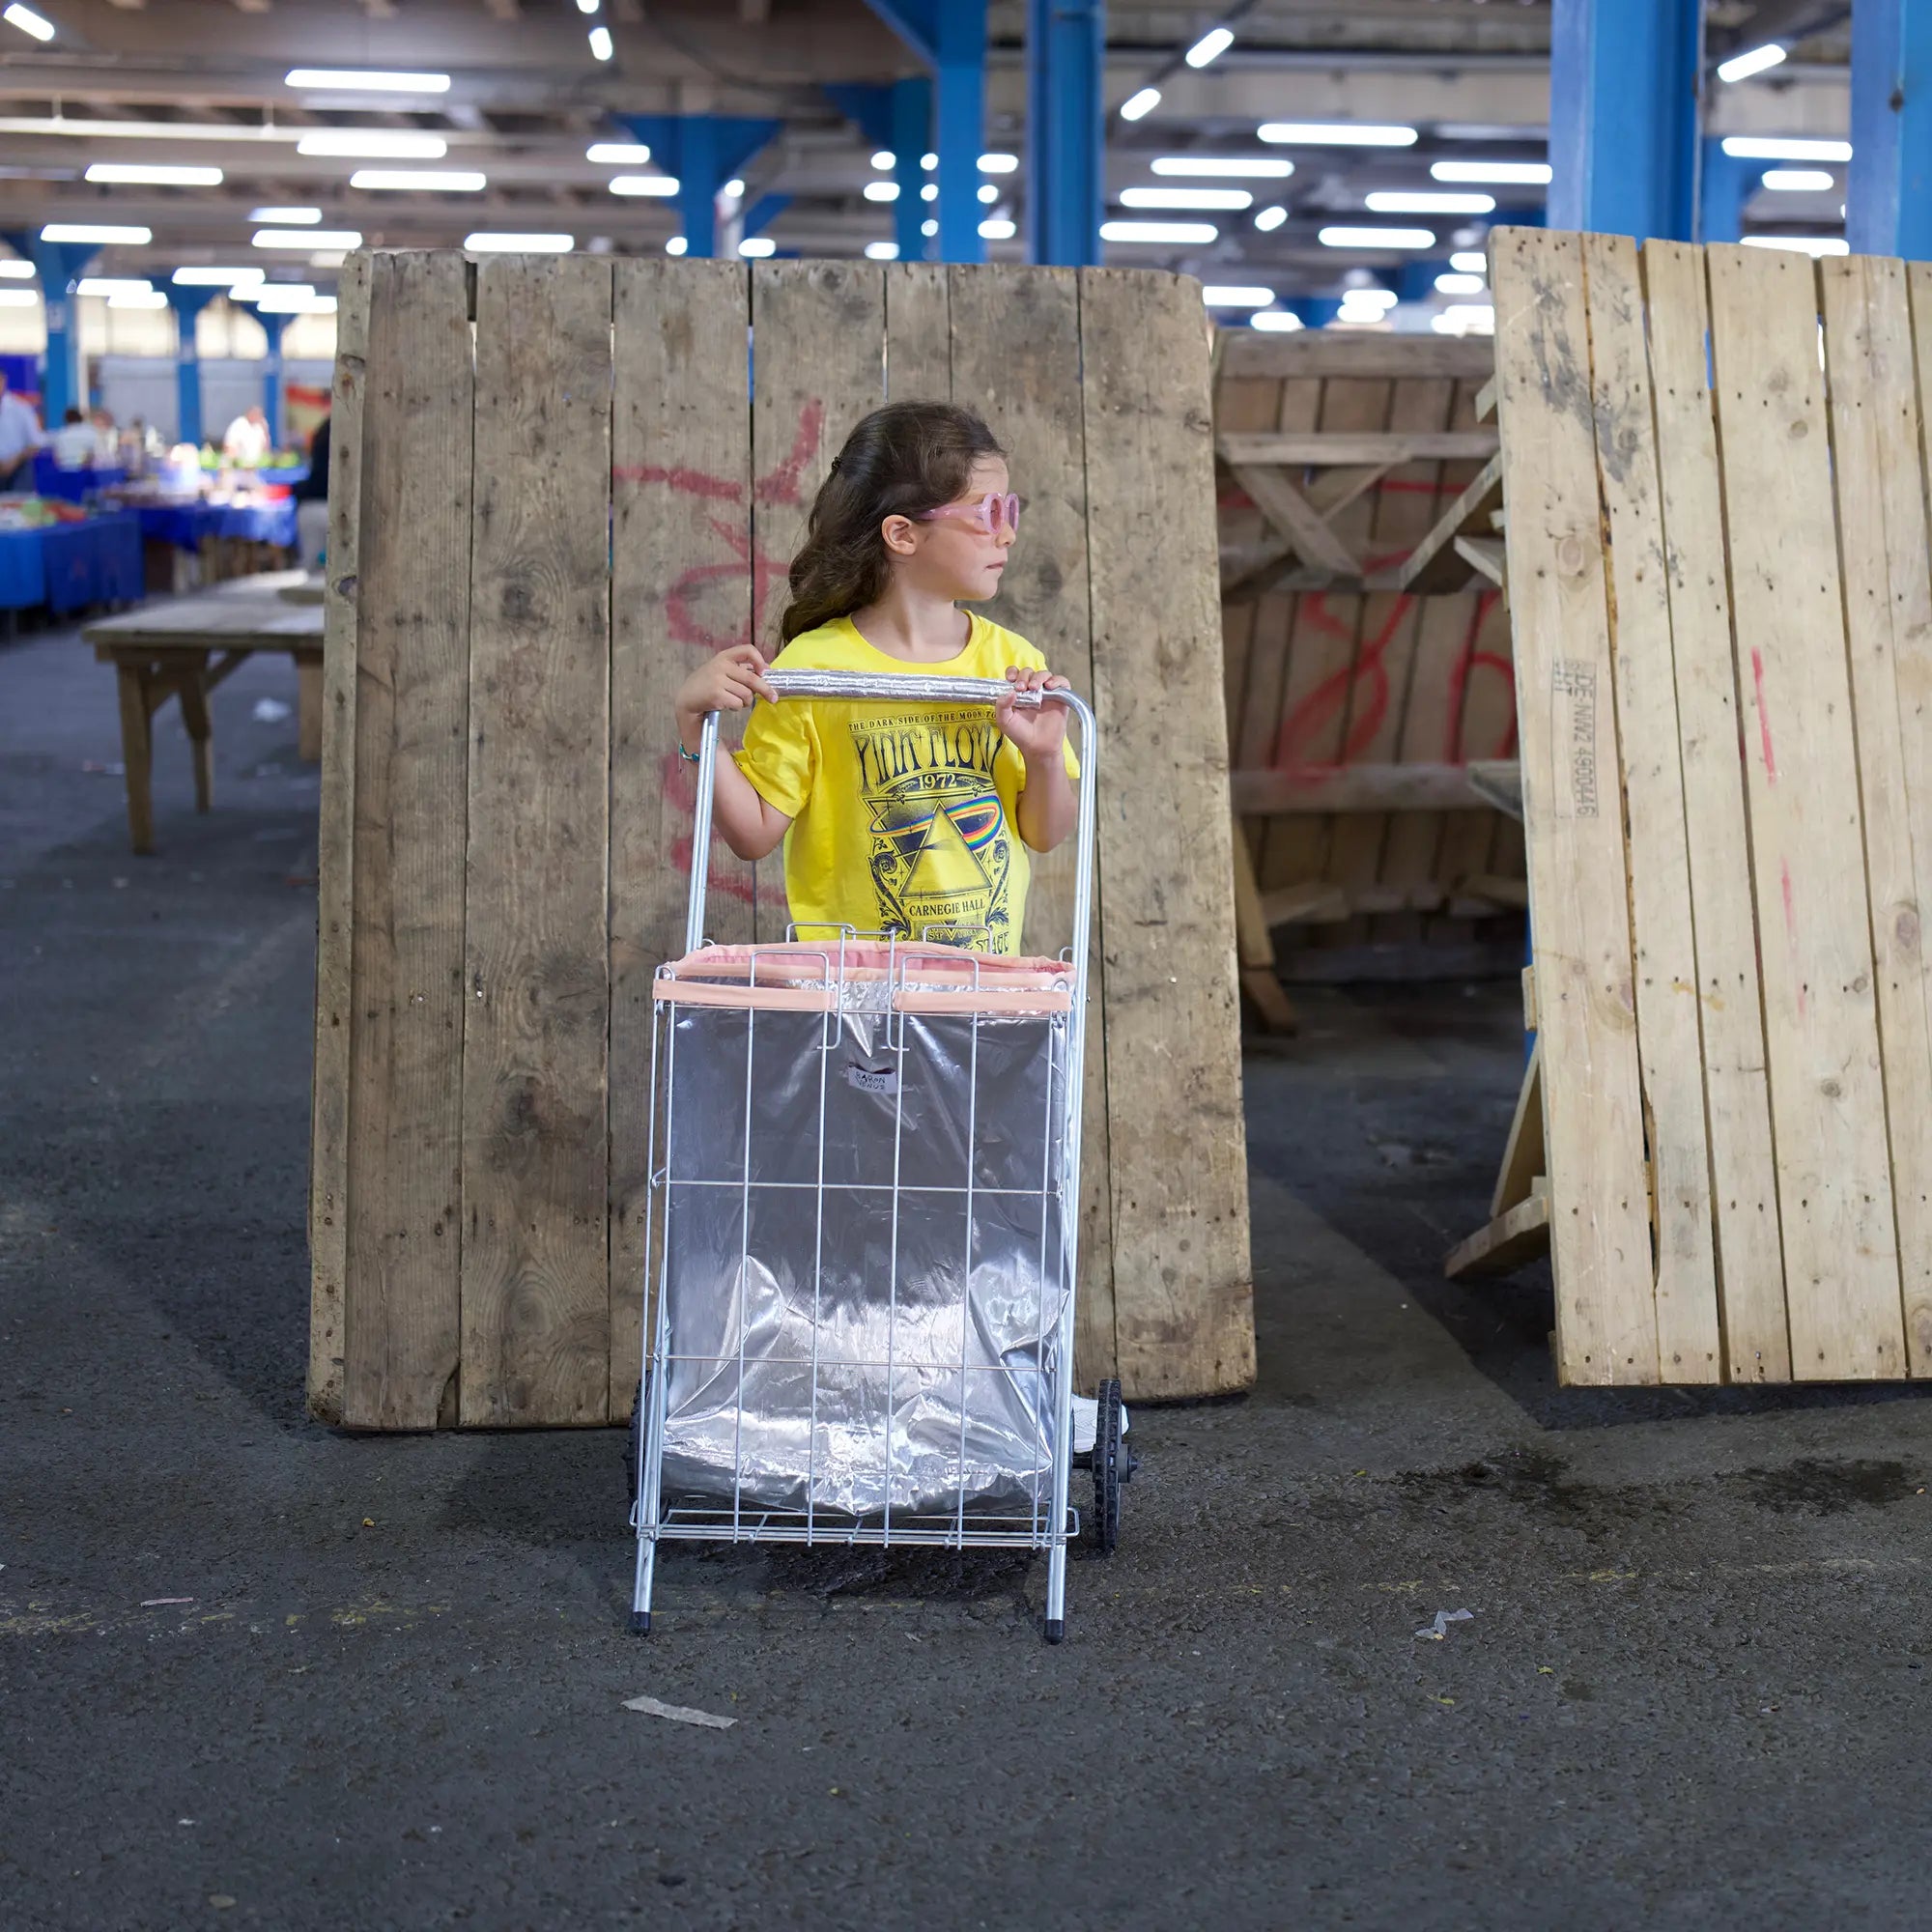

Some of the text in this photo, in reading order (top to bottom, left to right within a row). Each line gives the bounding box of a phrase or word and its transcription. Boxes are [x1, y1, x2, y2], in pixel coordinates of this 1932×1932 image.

[848, 724, 866, 732] THE
[869, 720, 895, 728] DARK
[898, 716, 920, 724] SIDE
[938, 713, 955, 722] THE
[959, 711, 981, 720] MOON
[918, 773, 957, 790] 1972
[909, 898, 985, 917] CARNEGIE HALL
